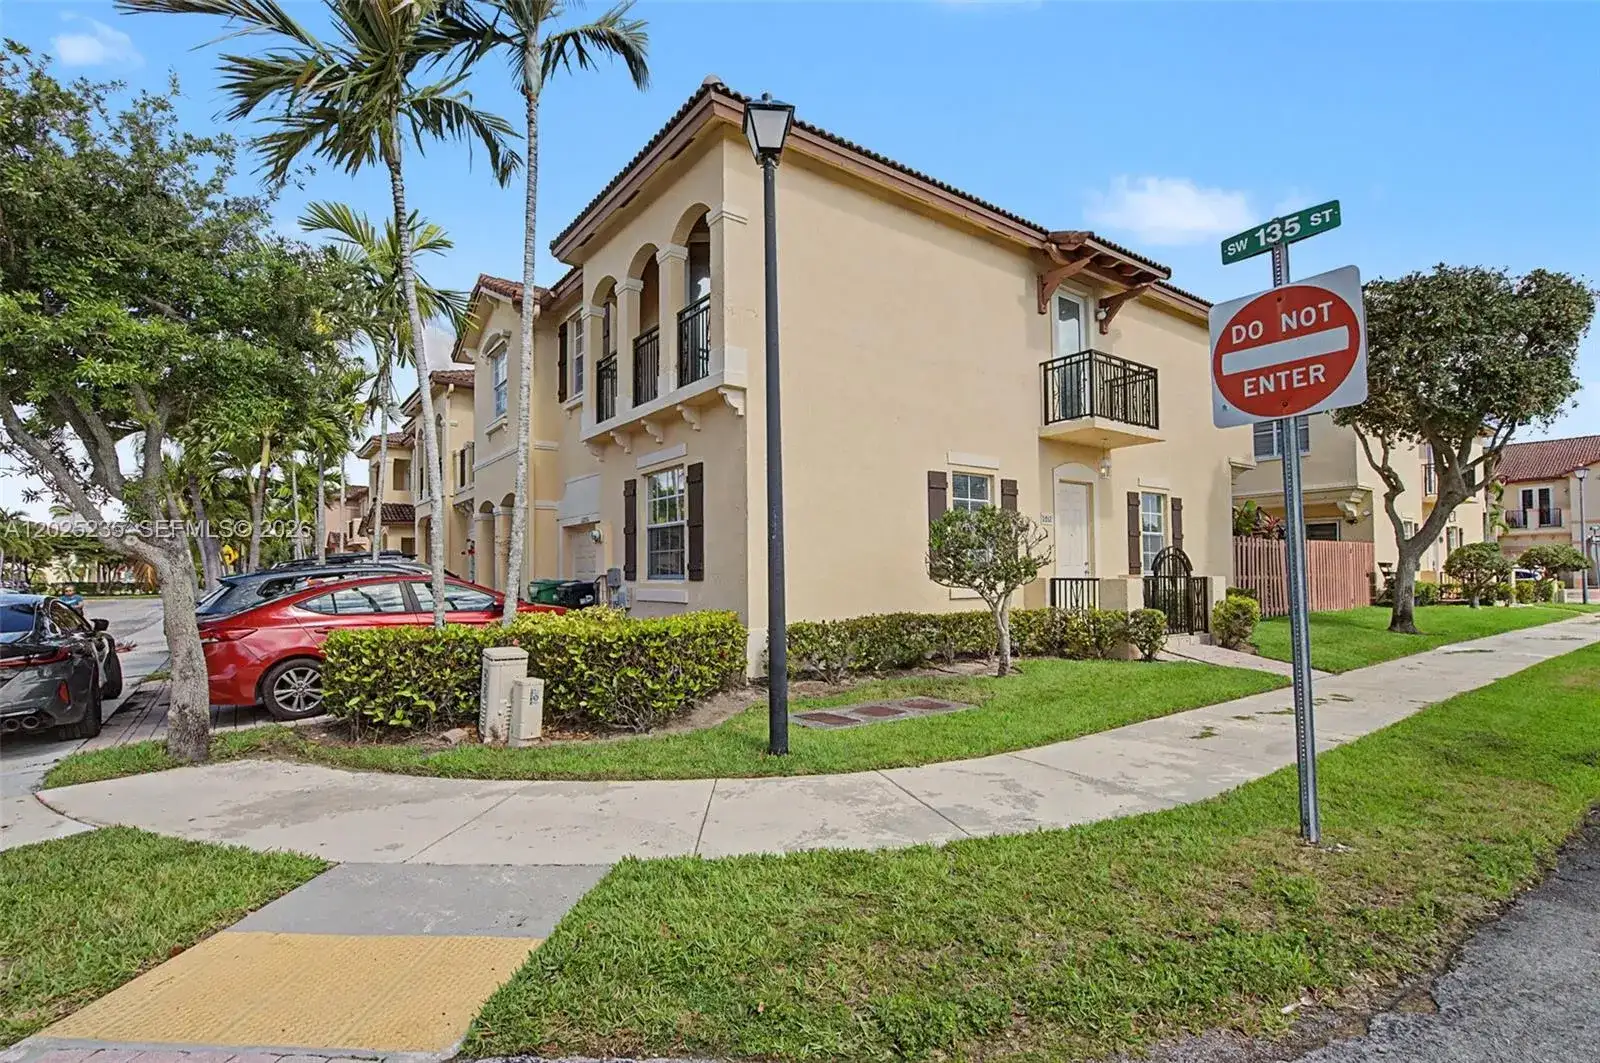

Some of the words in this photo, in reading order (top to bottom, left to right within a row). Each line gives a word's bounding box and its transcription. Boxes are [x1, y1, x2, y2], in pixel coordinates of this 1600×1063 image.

[1227, 238, 1248, 256] SW
[1255, 216, 1301, 246] 135
[1310, 208, 1334, 226] ST
[1231, 320, 1264, 345] DO
[1281, 301, 1333, 333] NOT
[1243, 363, 1326, 397] ENTER
